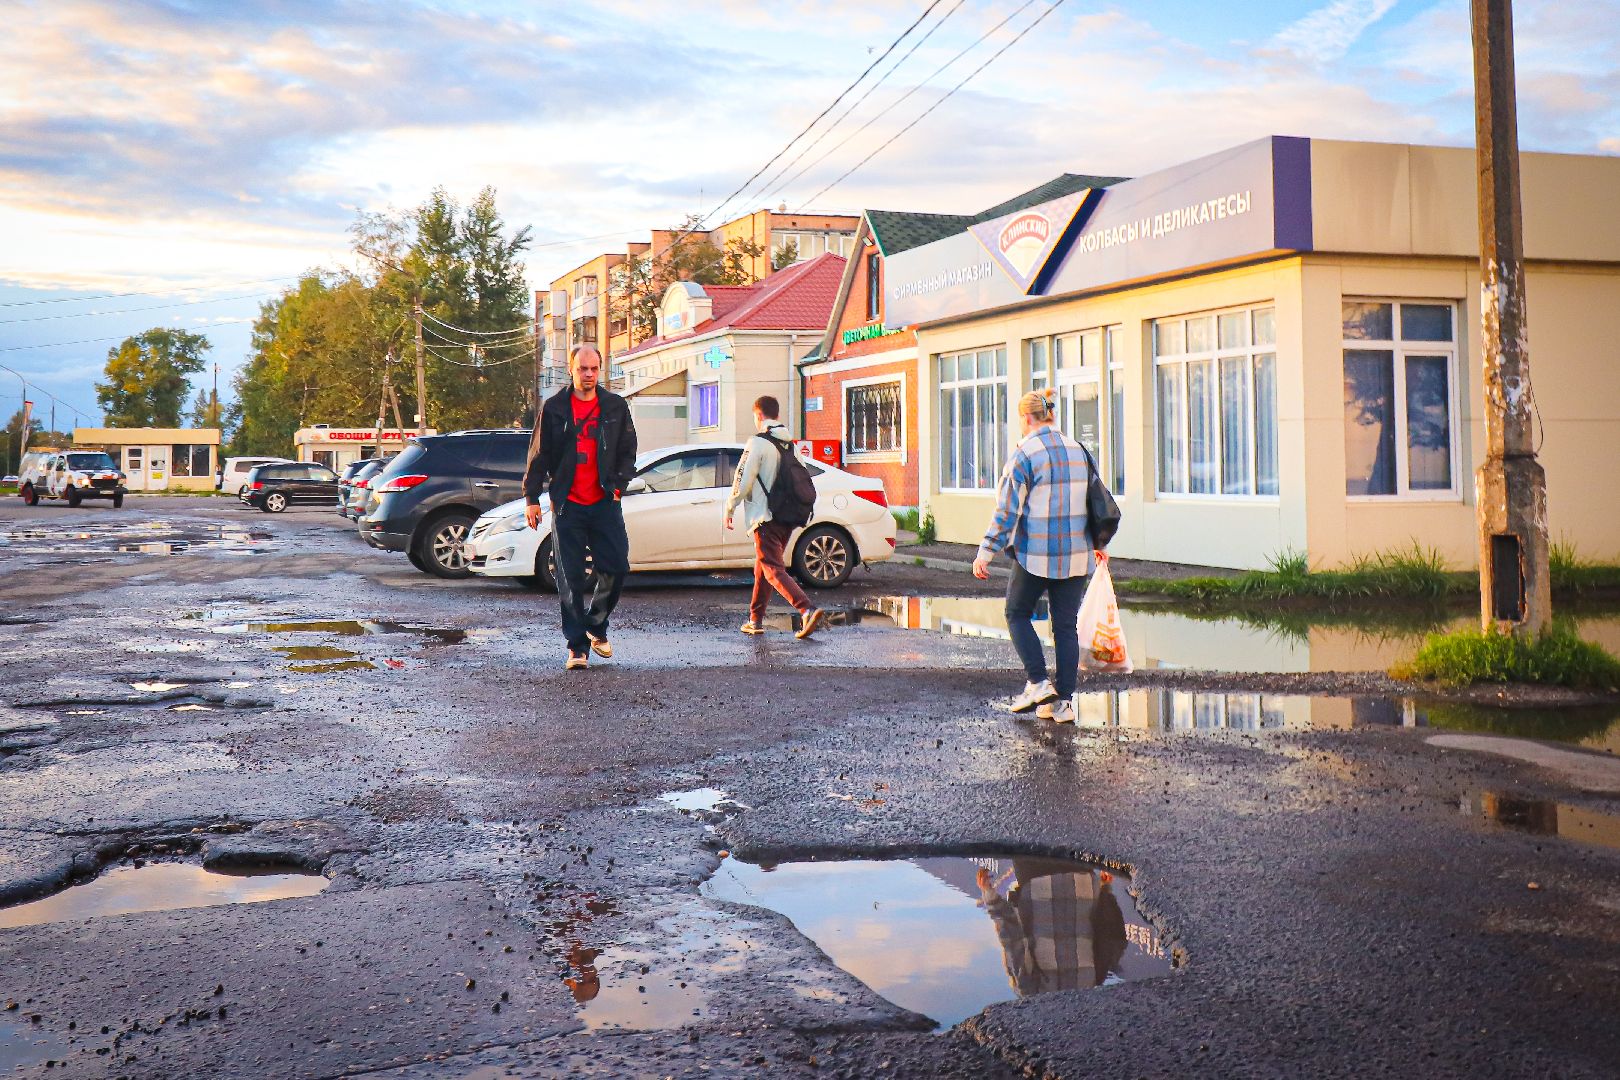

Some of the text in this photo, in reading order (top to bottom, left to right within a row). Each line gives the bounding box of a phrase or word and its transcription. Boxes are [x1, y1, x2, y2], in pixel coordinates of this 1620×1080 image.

[1001, 218, 1048, 249] КЛИНСКИЙ
[1079, 190, 1252, 254] КОЛБАСЫ И ДЕЛИКАТЕСЫ
[893, 261, 993, 300] ФИРМЕННЫЙ МАГАЗИН
[329, 432, 372, 441] ОВОЩИ
